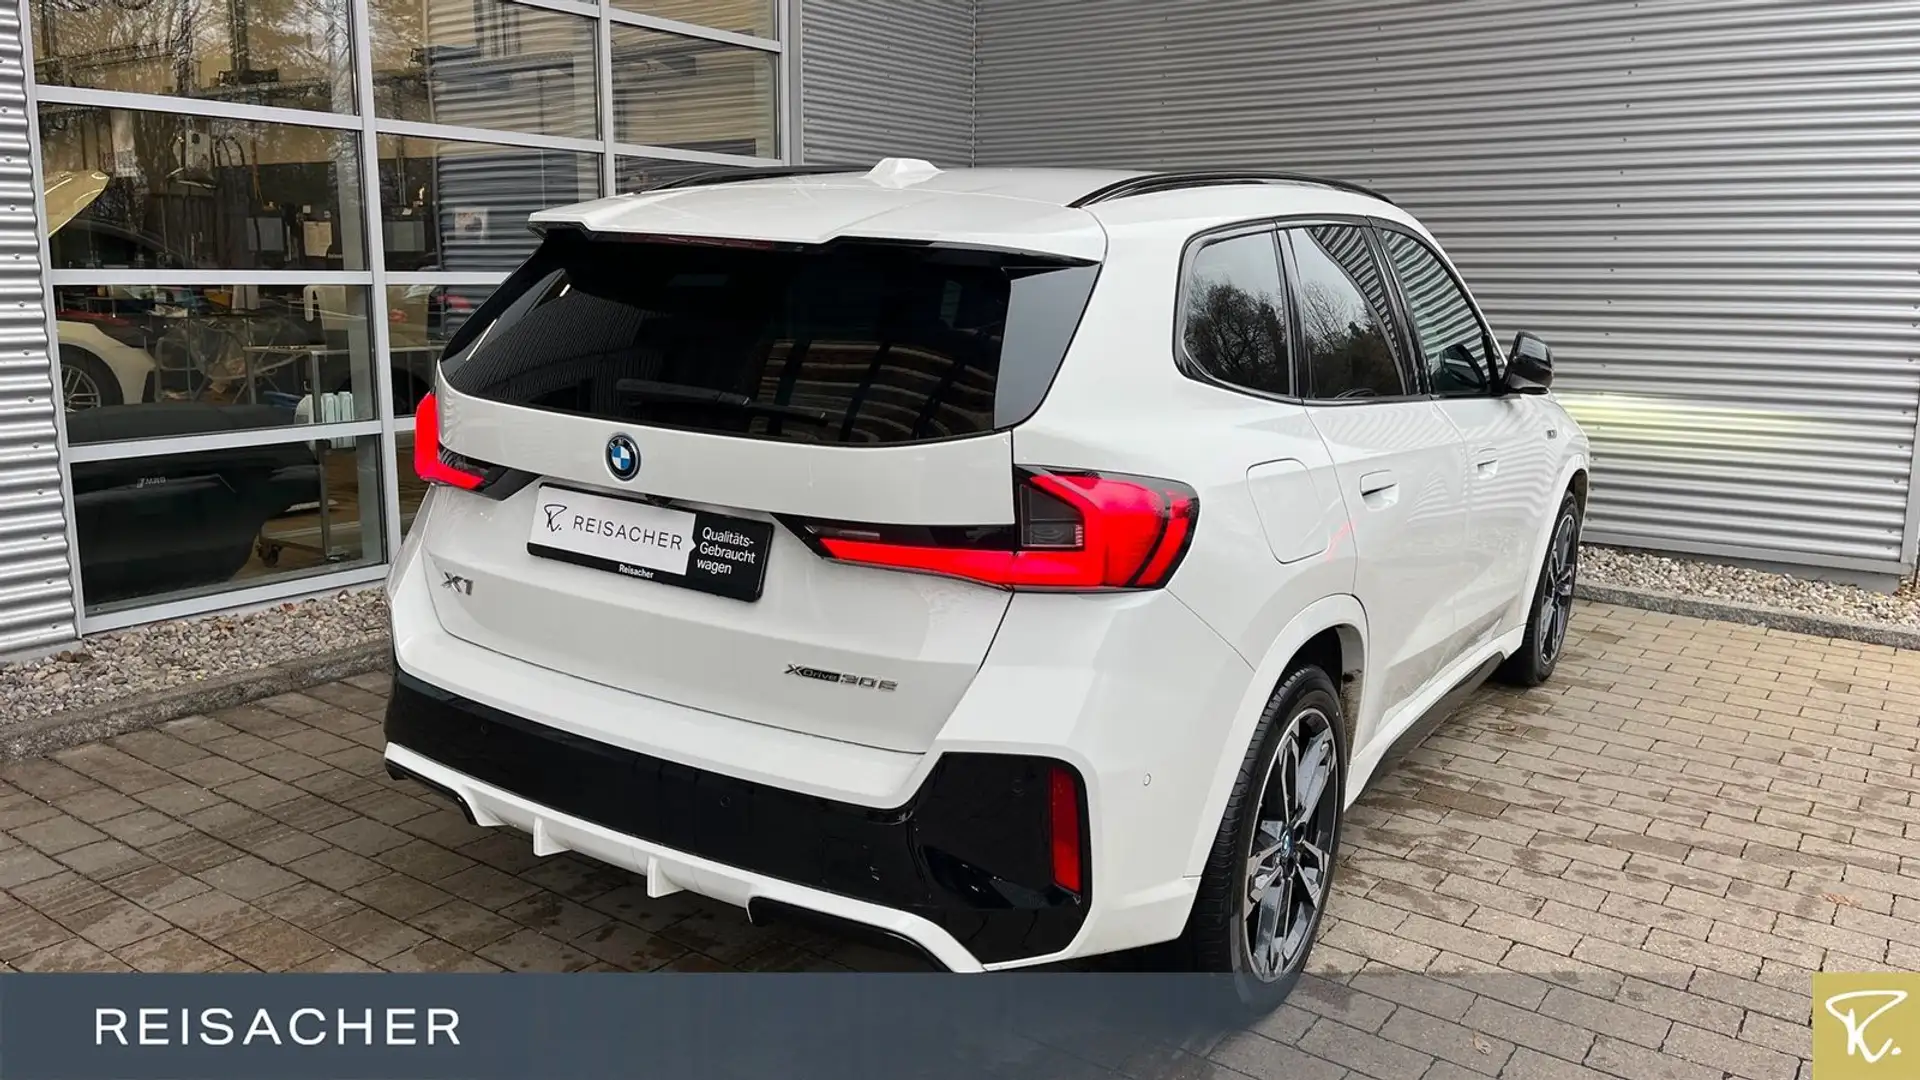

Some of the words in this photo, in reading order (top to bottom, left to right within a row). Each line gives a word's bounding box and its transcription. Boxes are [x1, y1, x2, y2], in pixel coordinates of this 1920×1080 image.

[572, 515, 683, 550] REISACHER
[702, 526, 755, 548] Qualitäts-
[699, 541, 756, 564] Gebraucht
[619, 563, 655, 579] Reisacher
[697, 558, 732, 575] wagen
[441, 571, 474, 596] X1
